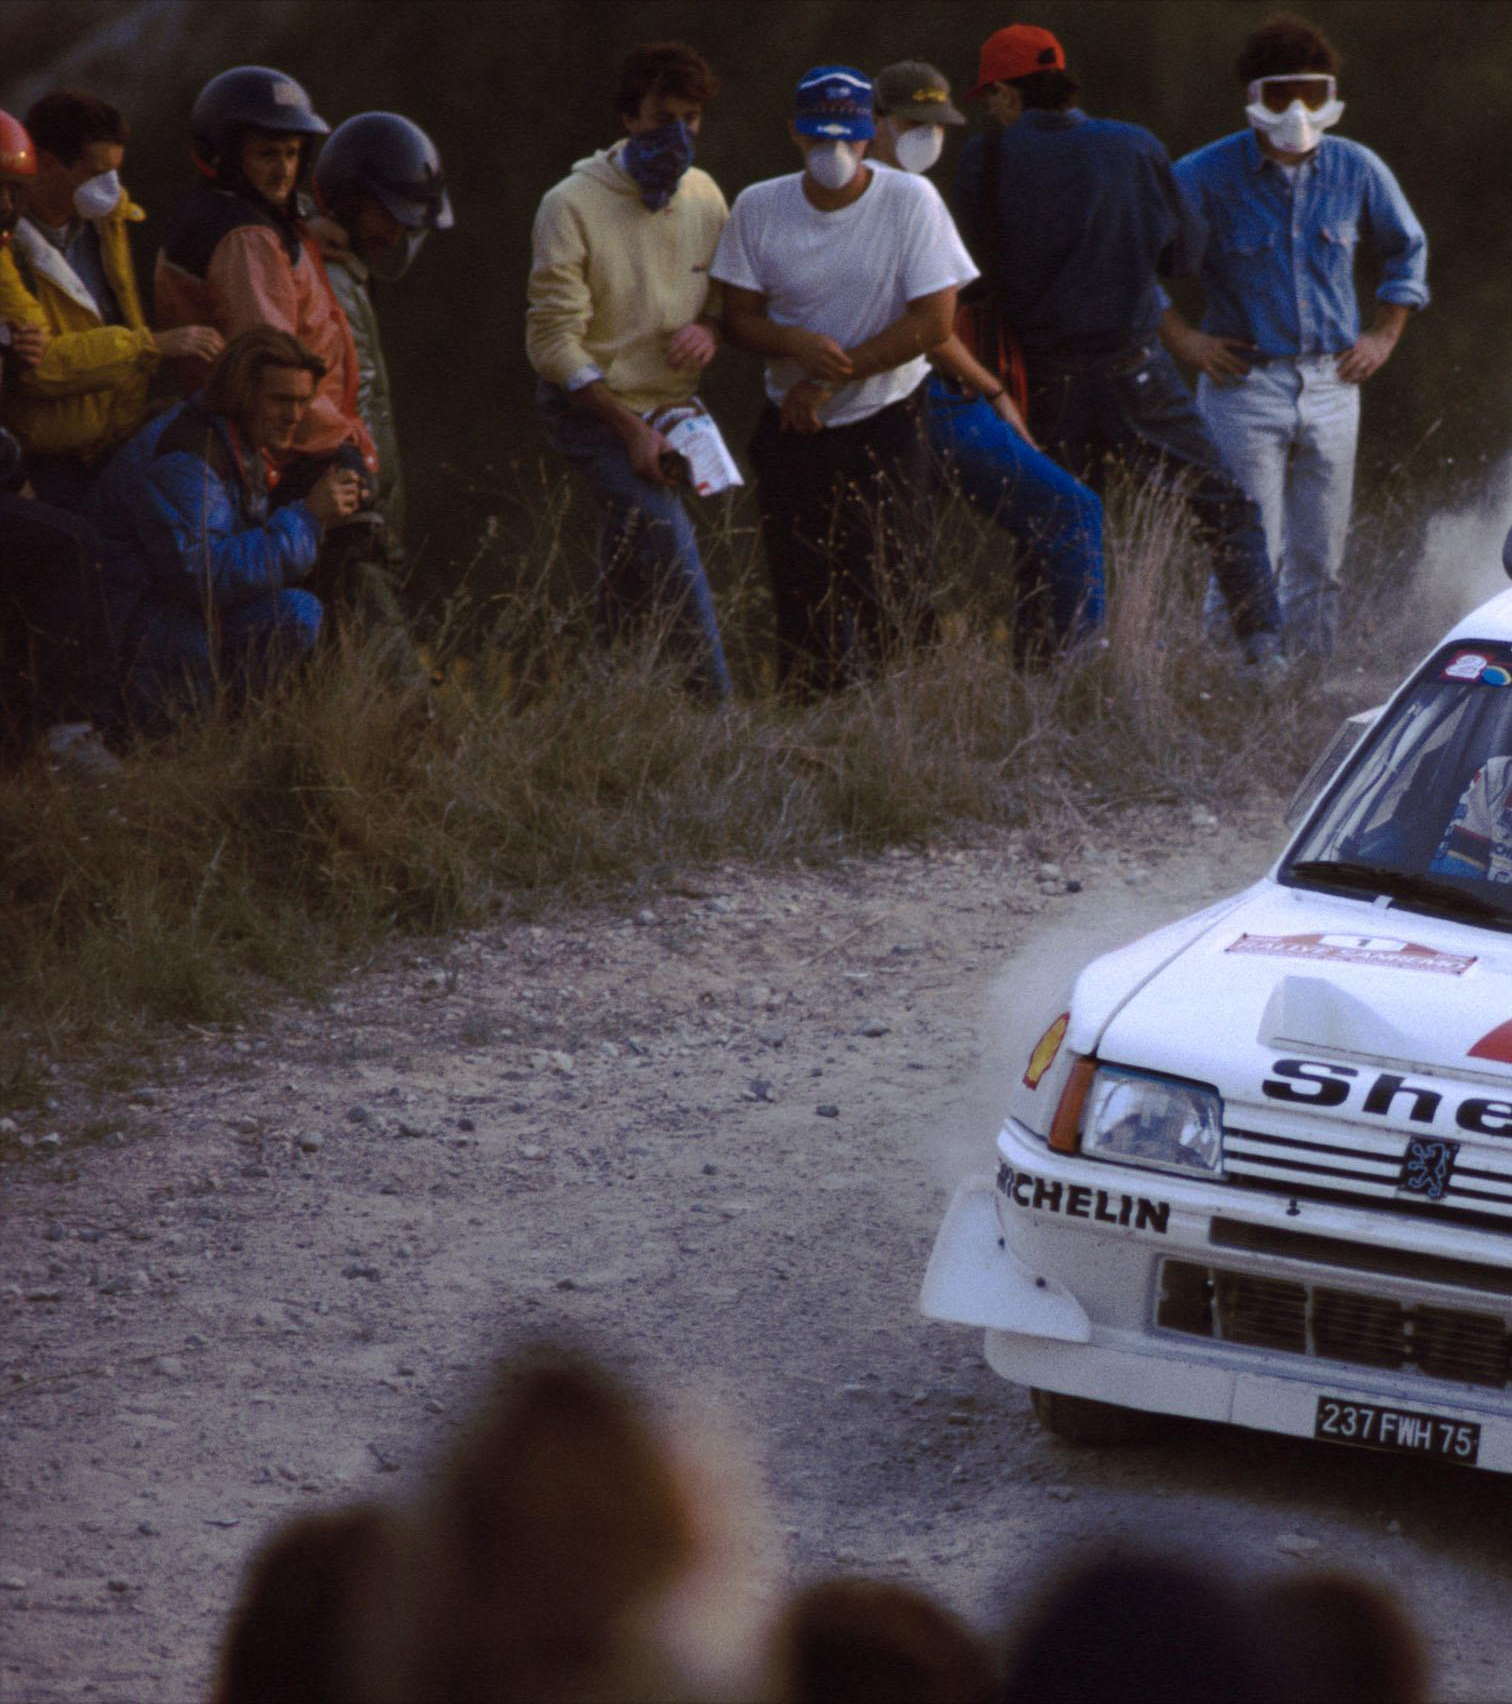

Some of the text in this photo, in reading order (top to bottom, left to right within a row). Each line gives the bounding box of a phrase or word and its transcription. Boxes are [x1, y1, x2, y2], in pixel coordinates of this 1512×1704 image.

[1322, 1403, 1473, 1457] 237 FWH 75
